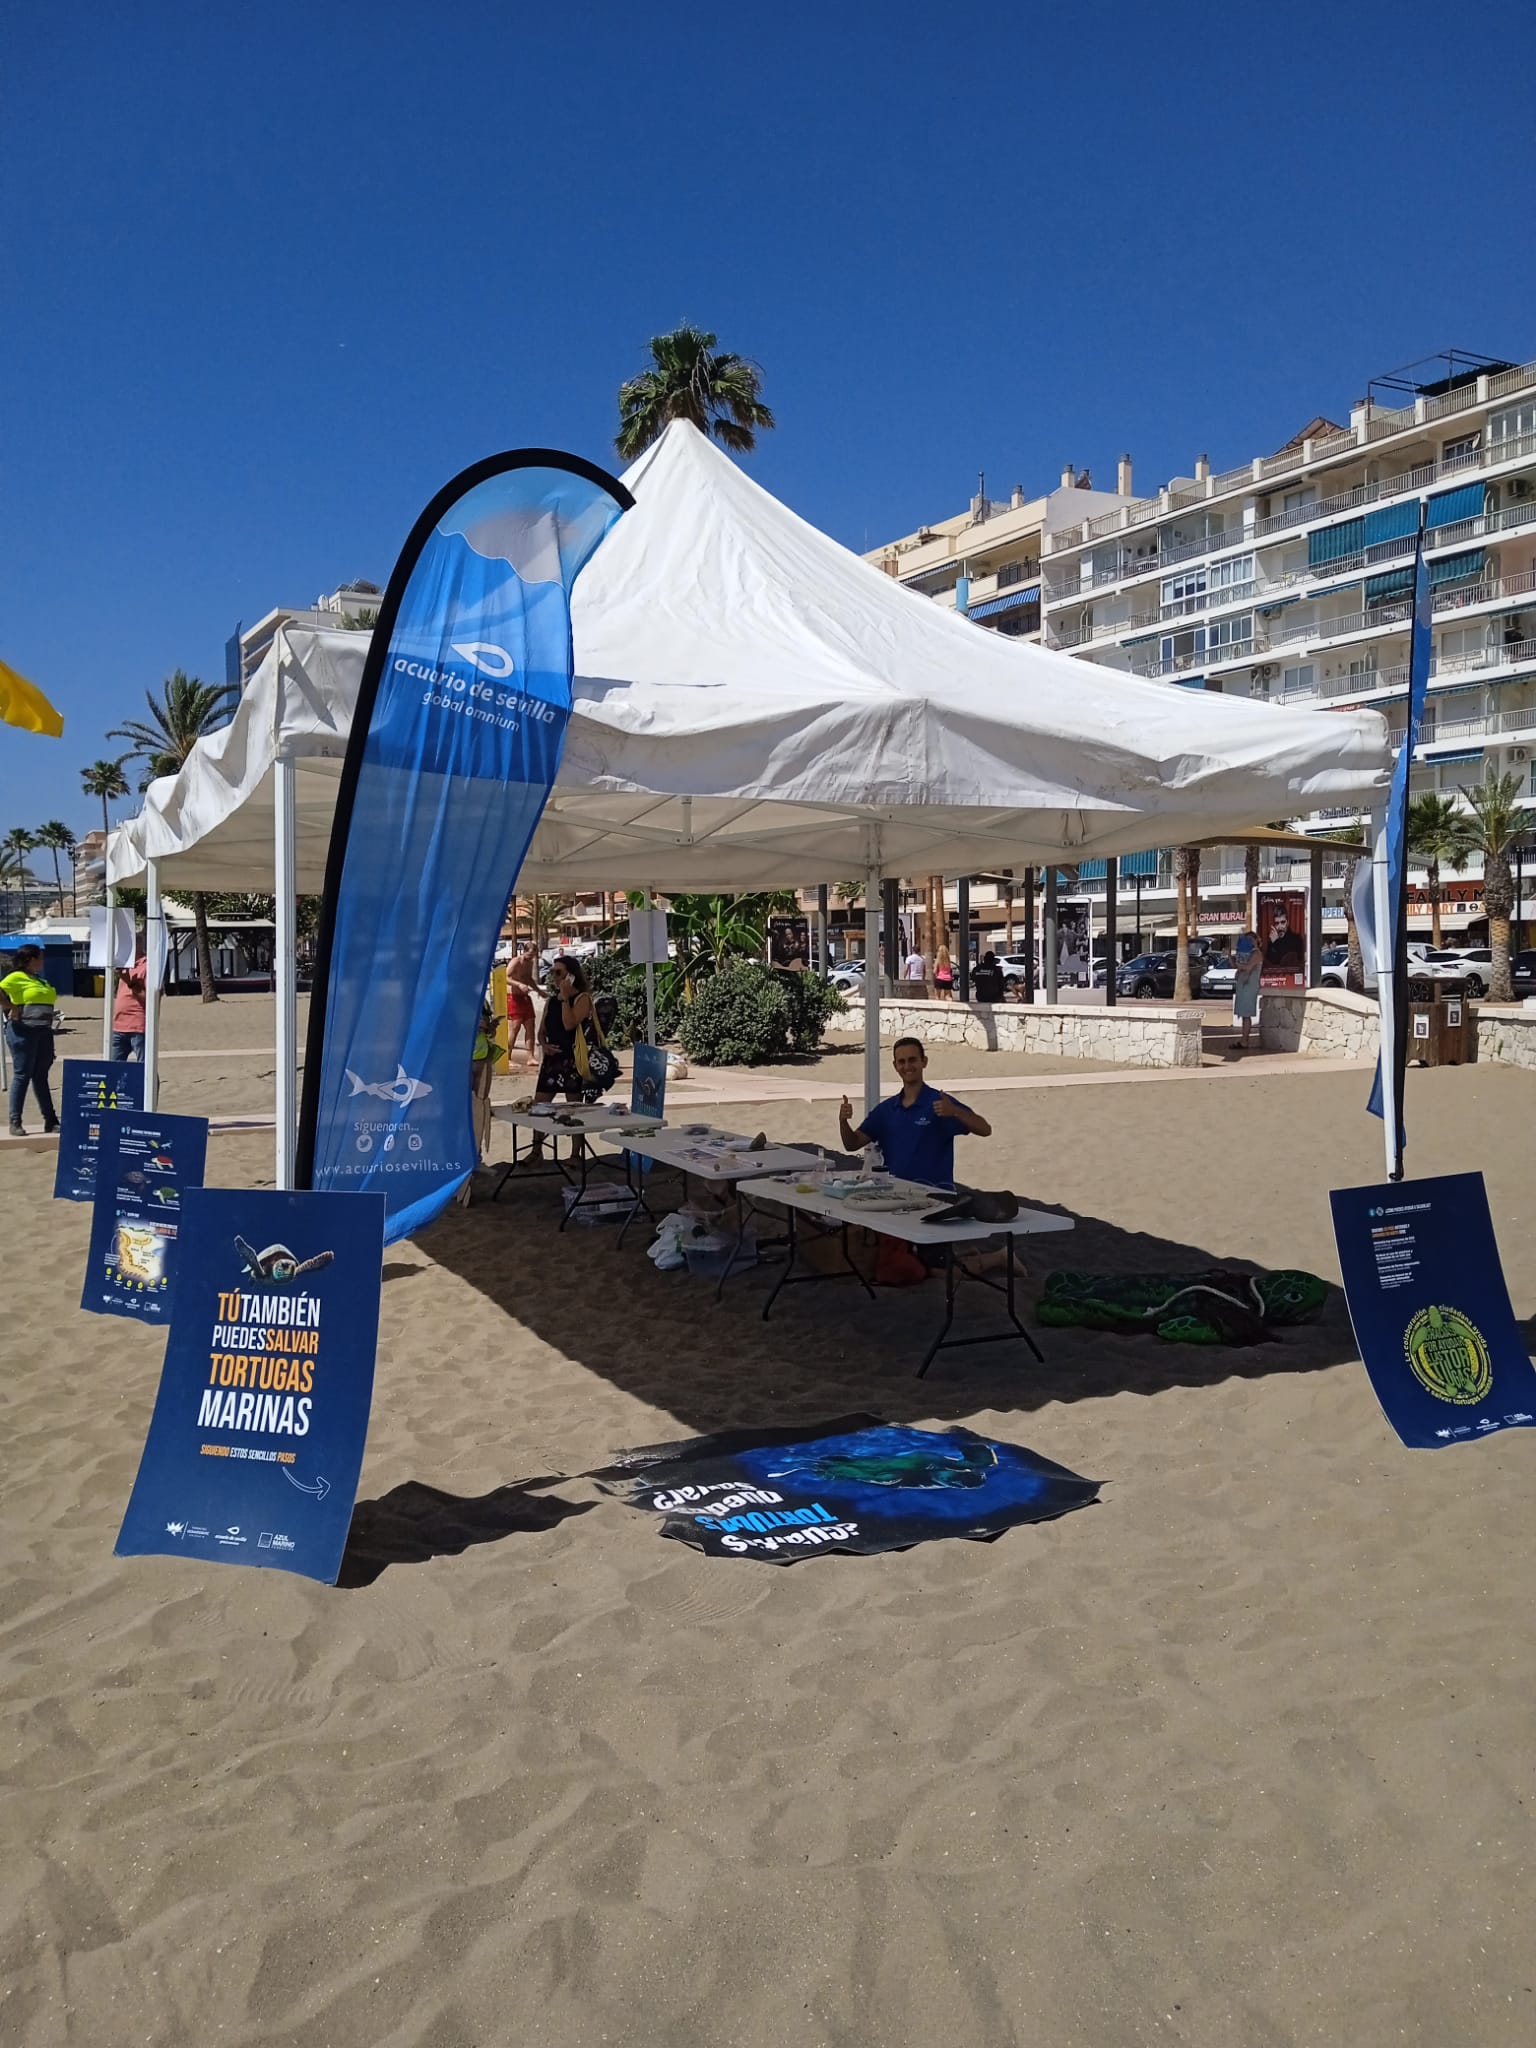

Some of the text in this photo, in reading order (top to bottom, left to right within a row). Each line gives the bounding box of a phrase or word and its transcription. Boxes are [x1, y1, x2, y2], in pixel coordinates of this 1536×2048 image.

[394, 658, 556, 723] acuario de sevilla
[422, 692, 520, 733] global omnium
[1407, 889, 1467, 904] FAILY
[1427, 903, 1455, 913] MRT
[1199, 913, 1219, 921] GRAN
[218, 1288, 321, 1328] TÚ TAMBIÉN
[1438, 1304, 1473, 1326] ciudadana
[212, 1325, 320, 1355] PUEDES SALVAR
[1403, 1308, 1428, 1350] colaboración
[209, 1353, 315, 1393] TORTUGAS
[197, 1389, 313, 1436] MARINAS
[230, 1447, 248, 1459] ESTOS
[247, 1449, 277, 1462] SENCILLOS
